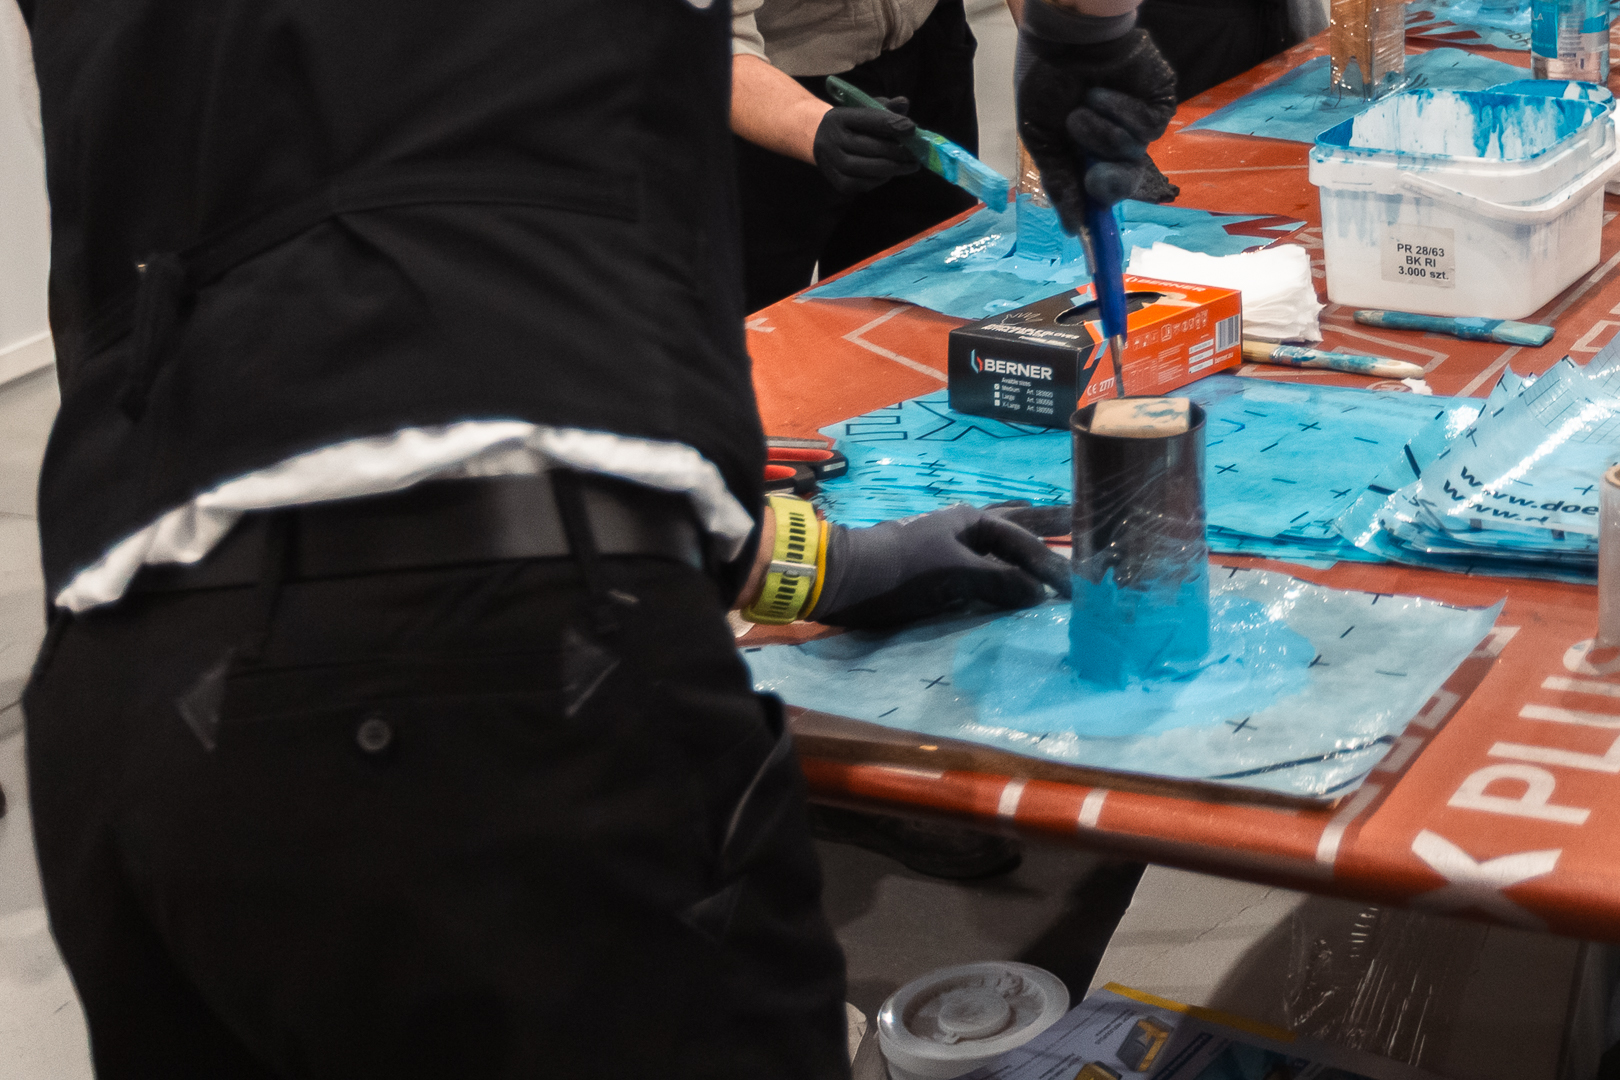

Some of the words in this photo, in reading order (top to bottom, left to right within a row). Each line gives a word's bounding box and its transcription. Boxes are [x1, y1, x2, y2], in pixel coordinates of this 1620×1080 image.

[1397, 243, 1413, 254] PR
[1416, 246, 1445, 257] 28/63
[1406, 255, 1421, 266] BK
[1425, 257, 1436, 267] RI
[1398, 266, 1426, 278] 3.000
[1430, 271, 1449, 280] szt.
[1137, 276, 1207, 293] BERNER
[984, 358, 1053, 380] BERNER
